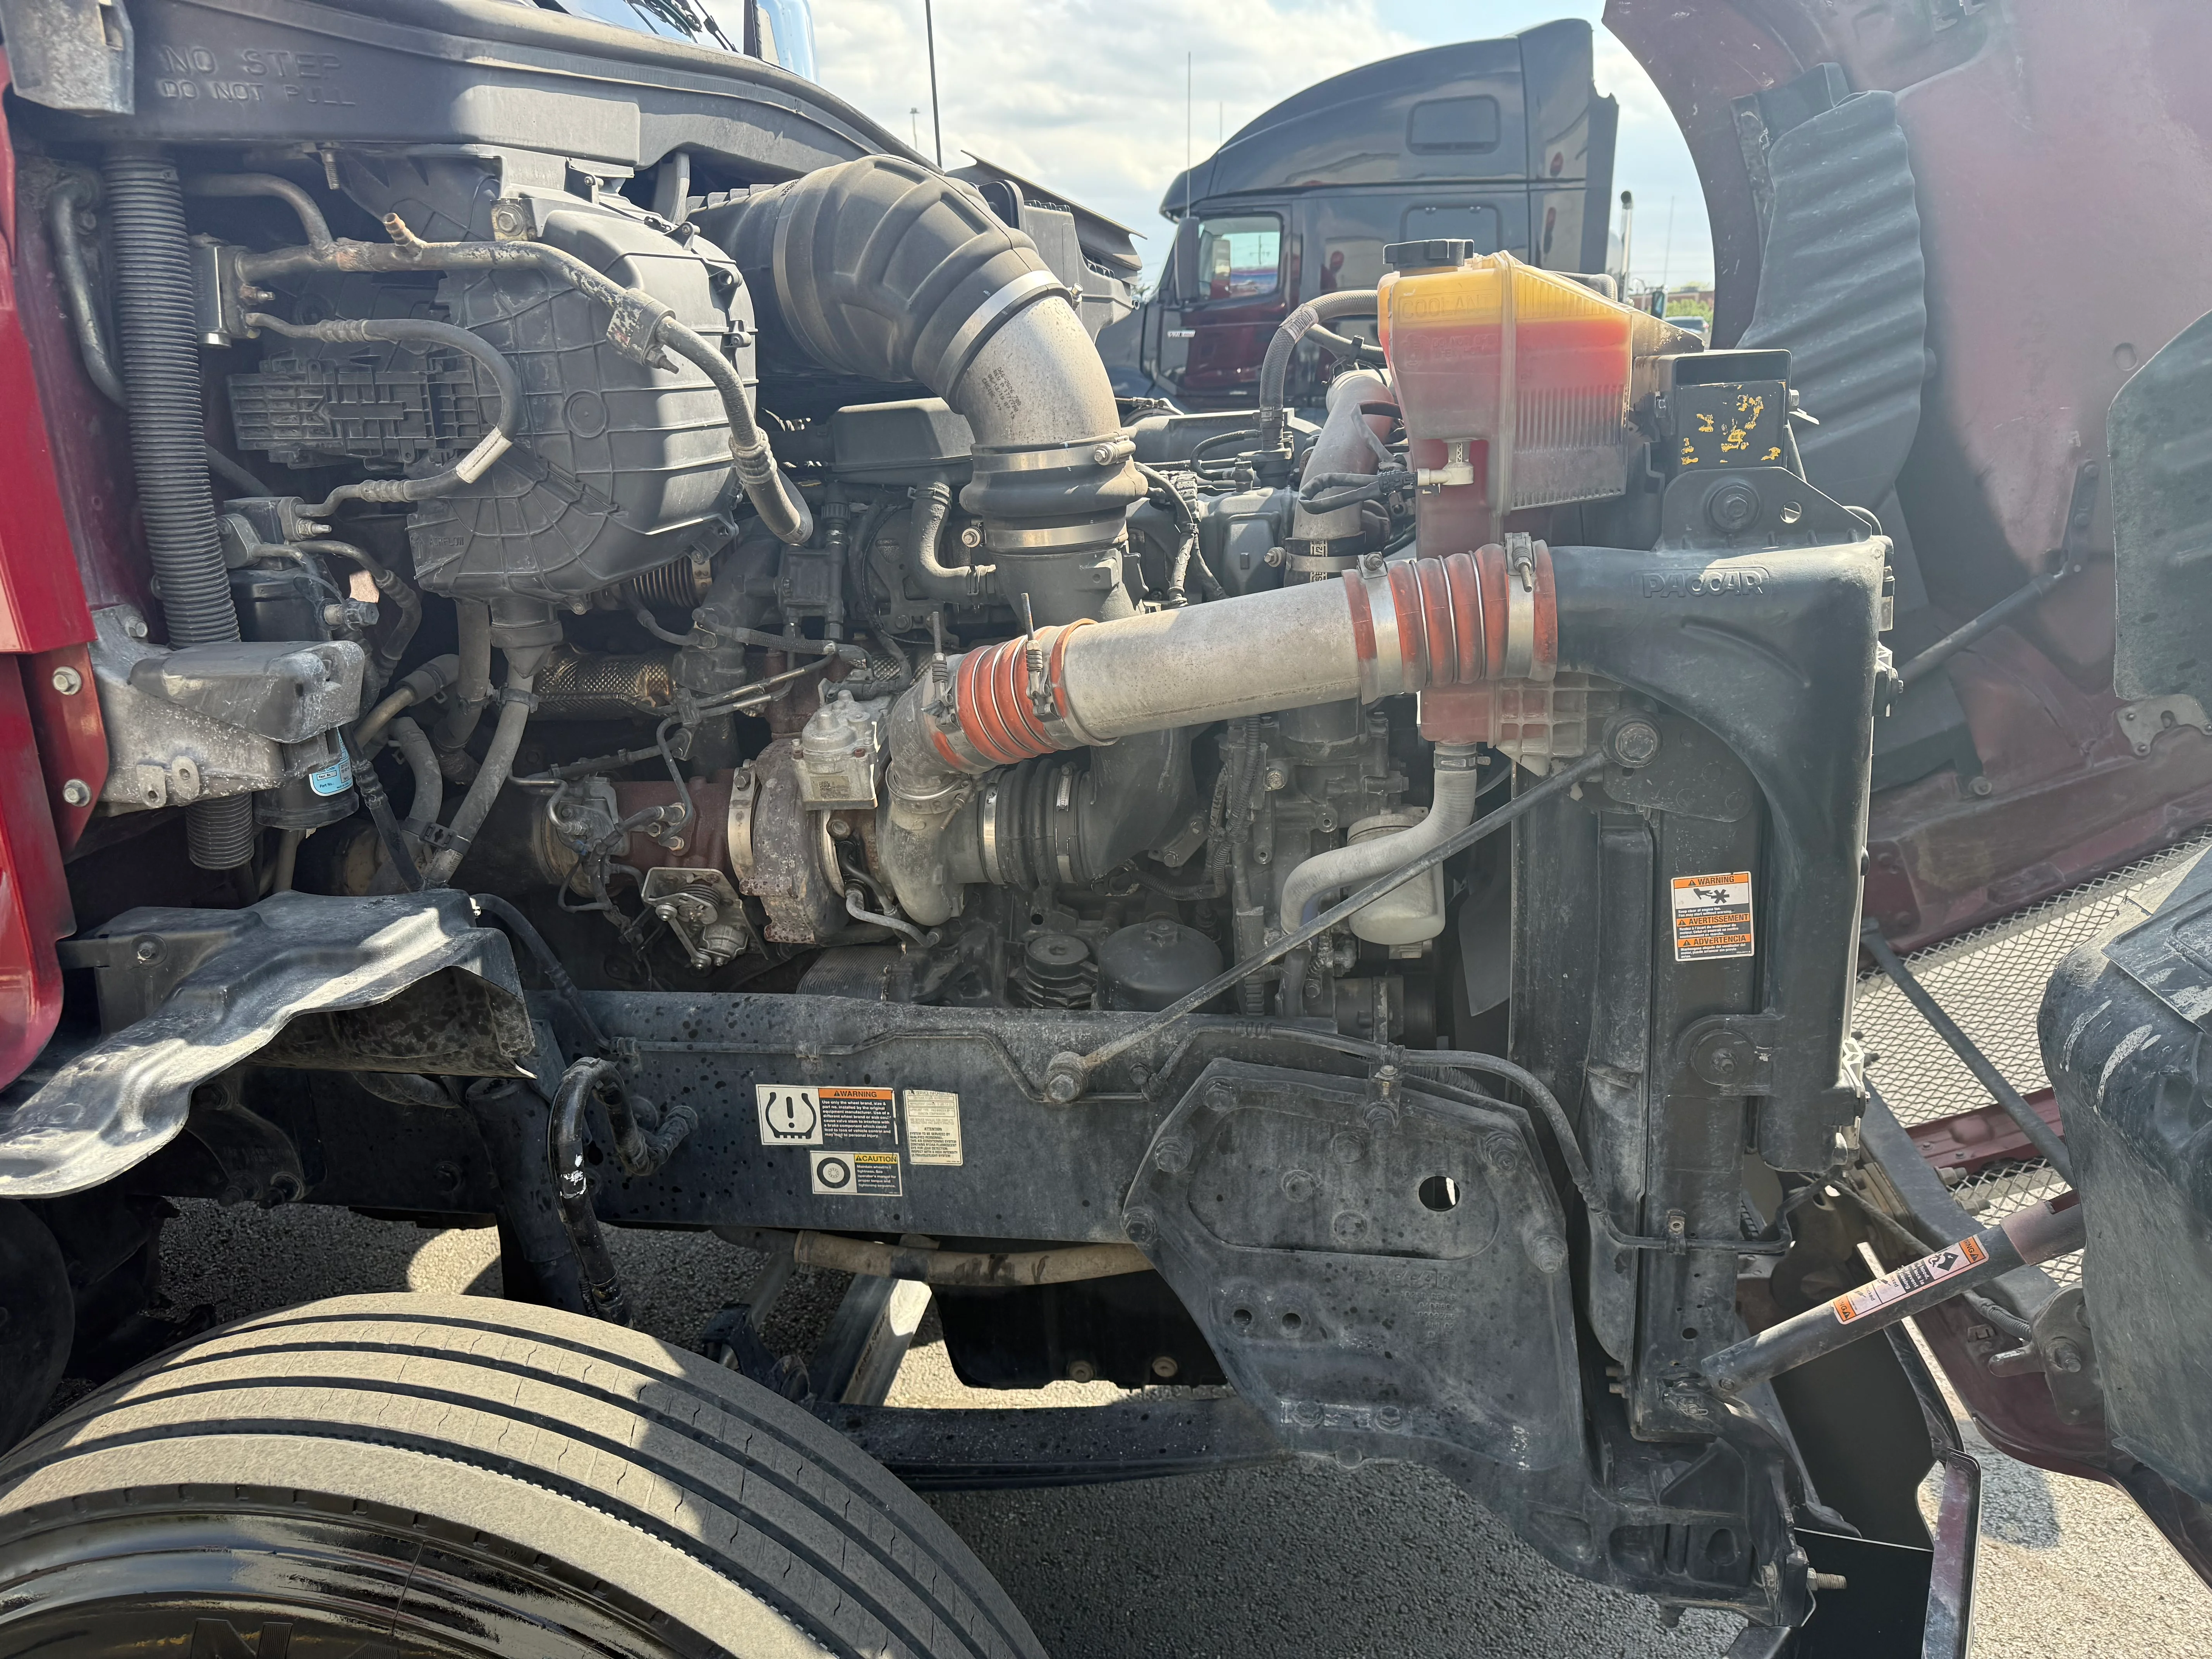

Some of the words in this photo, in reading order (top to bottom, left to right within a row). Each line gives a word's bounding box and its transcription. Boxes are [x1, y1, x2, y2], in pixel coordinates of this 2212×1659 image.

[162, 45, 217, 74] NO
[242, 49, 342, 77] STEP
[161, 80, 197, 98] DO
[213, 82, 263, 100] NOT
[284, 84, 356, 105] PULL
[1402, 294, 1492, 318] COOLANT
[430, 536, 464, 546] AIRFLOW
[1642, 570, 1763, 598] PACCAR
[1698, 876, 1734, 885] WARNING
[1689, 914, 1748, 924] AVERTISSEMENT
[1694, 935, 1746, 945] ADVERTENCIA
[1905, 1270, 1918, 1288] prevent
[1913, 1269, 1922, 1279] lock
[1919, 1266, 1930, 1279] hood,
[1898, 1273, 1910, 1290] closing
